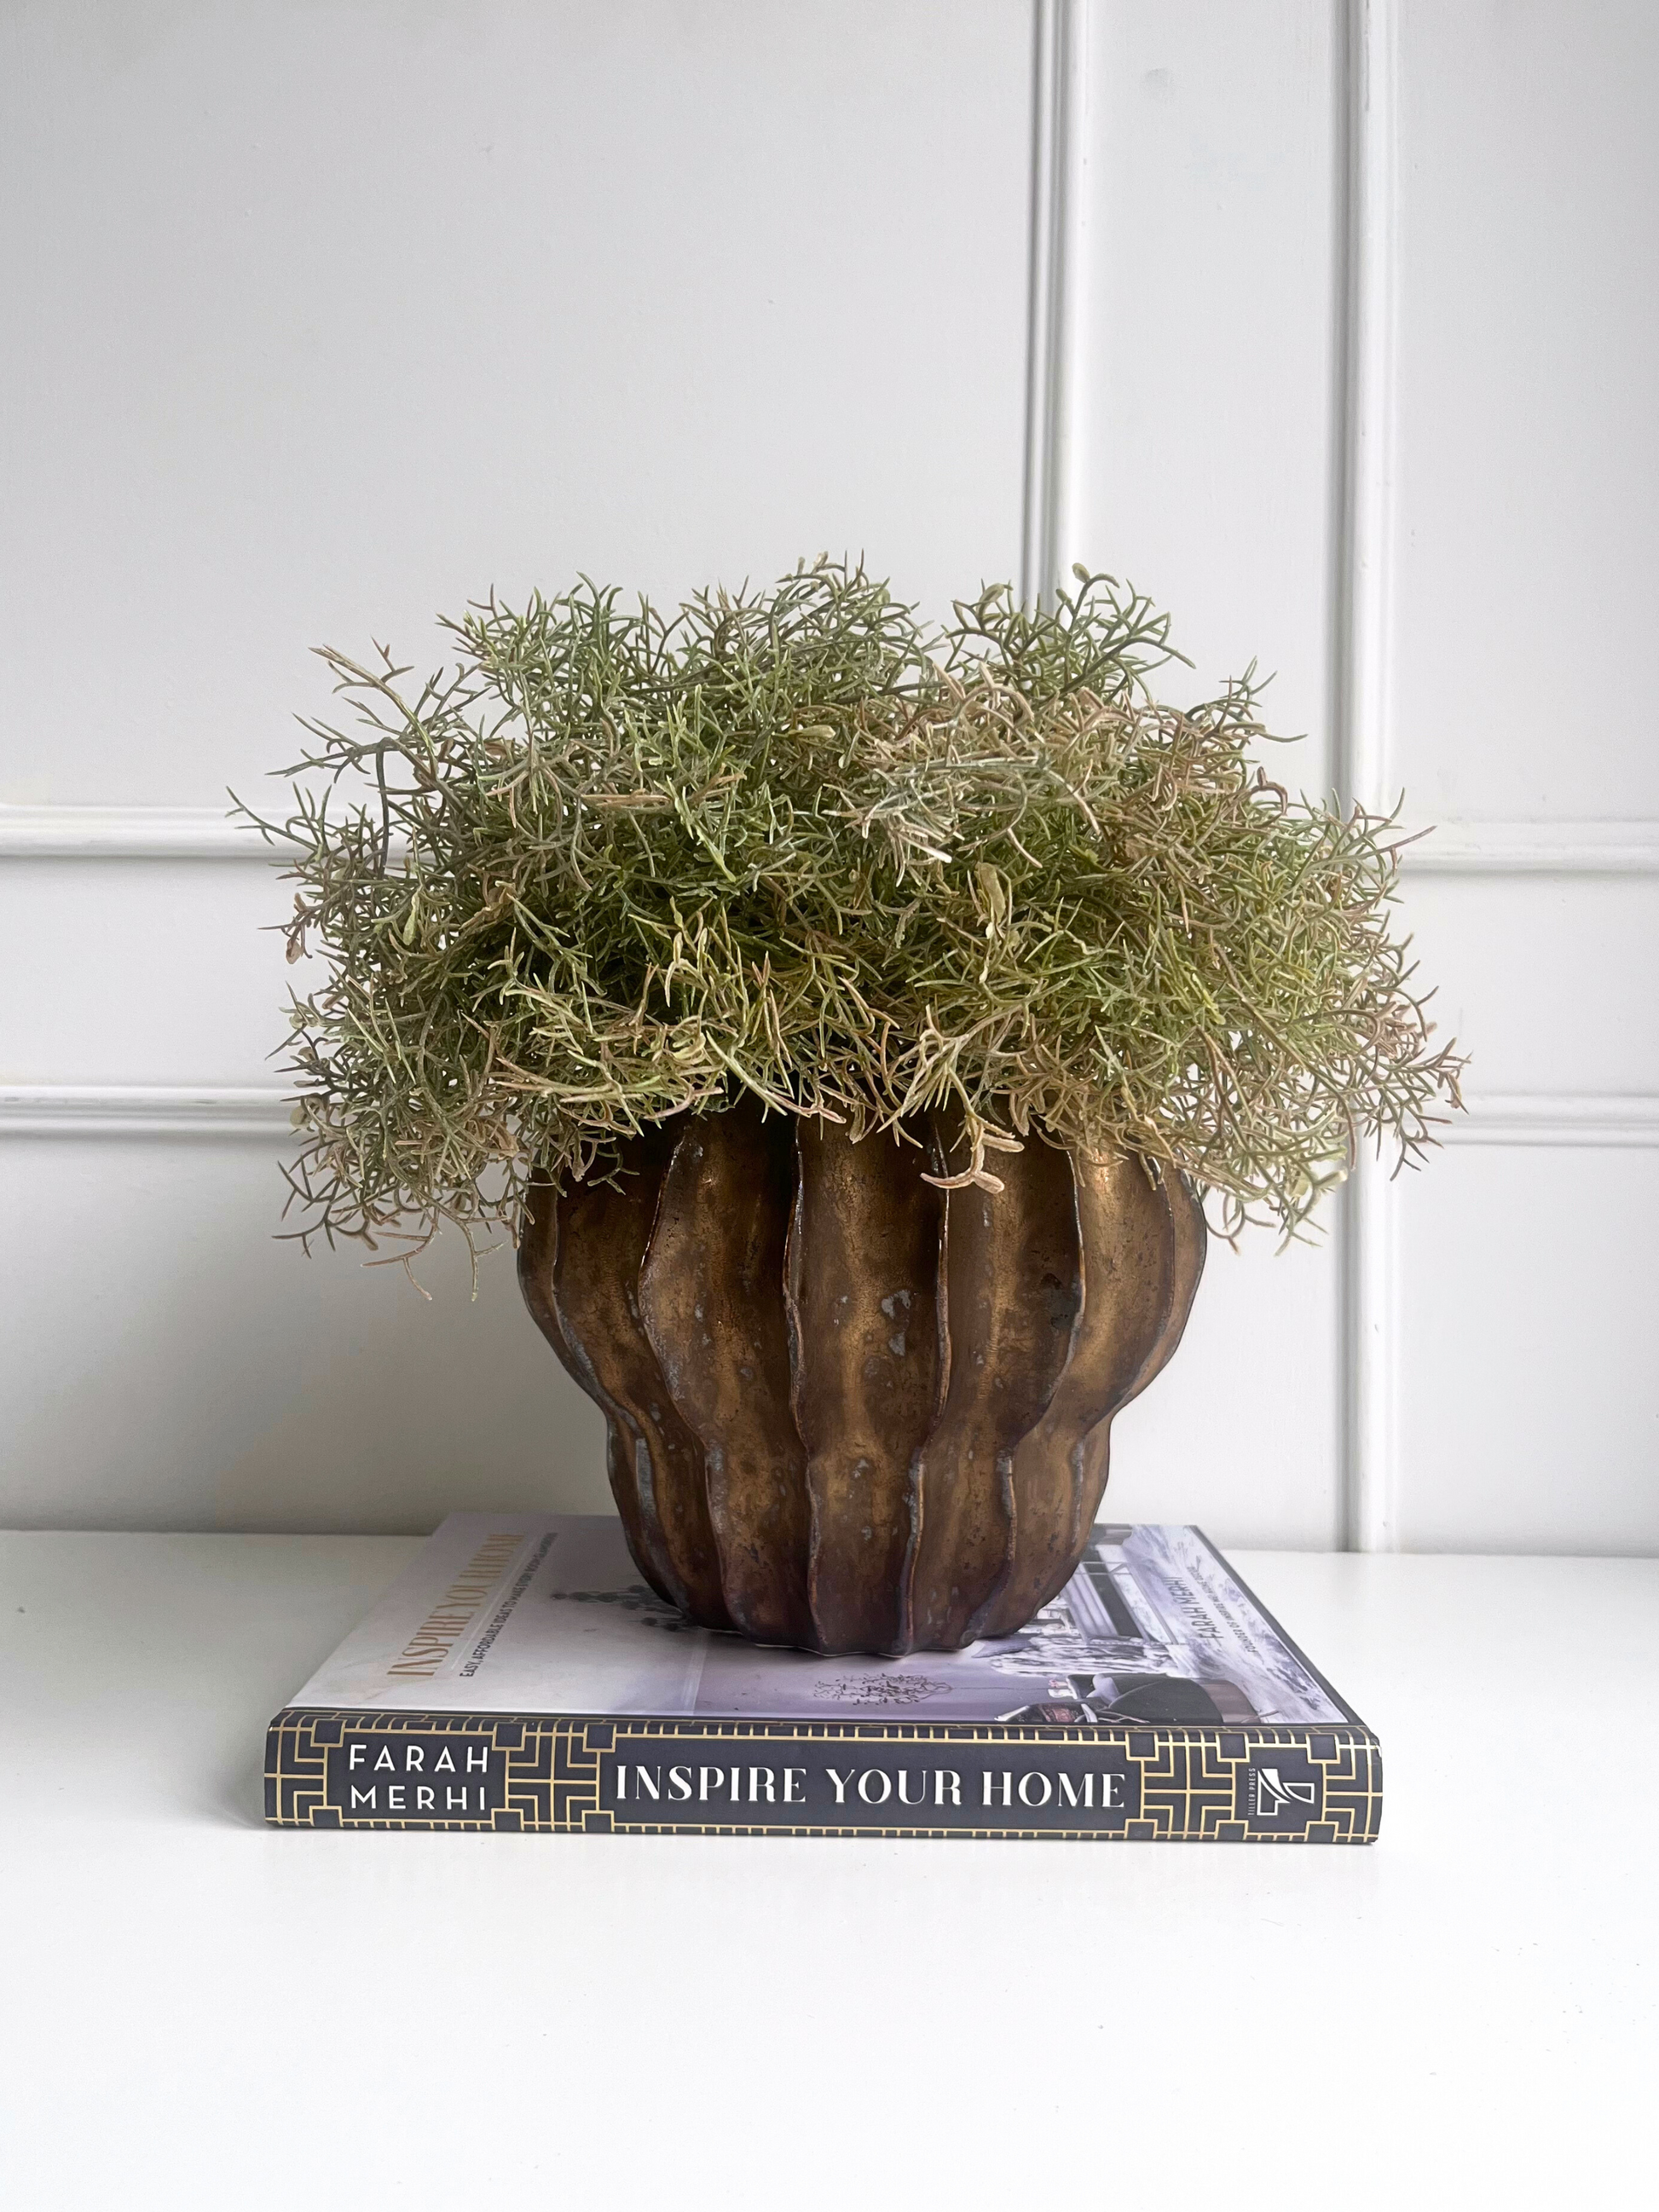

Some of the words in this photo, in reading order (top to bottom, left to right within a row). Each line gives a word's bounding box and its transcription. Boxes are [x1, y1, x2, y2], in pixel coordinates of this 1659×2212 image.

[1159, 1577, 1199, 1604] MERHI
[1181, 1607, 1224, 1638] FARAH
[386, 1611, 475, 1677] INSPIRE
[350, 1744, 488, 1772] FARAH
[350, 1784, 486, 1811] MERHI
[616, 1764, 806, 1803] INSPIRE
[825, 1768, 962, 1805] YOUR
[982, 1771, 1126, 1808] HOME
